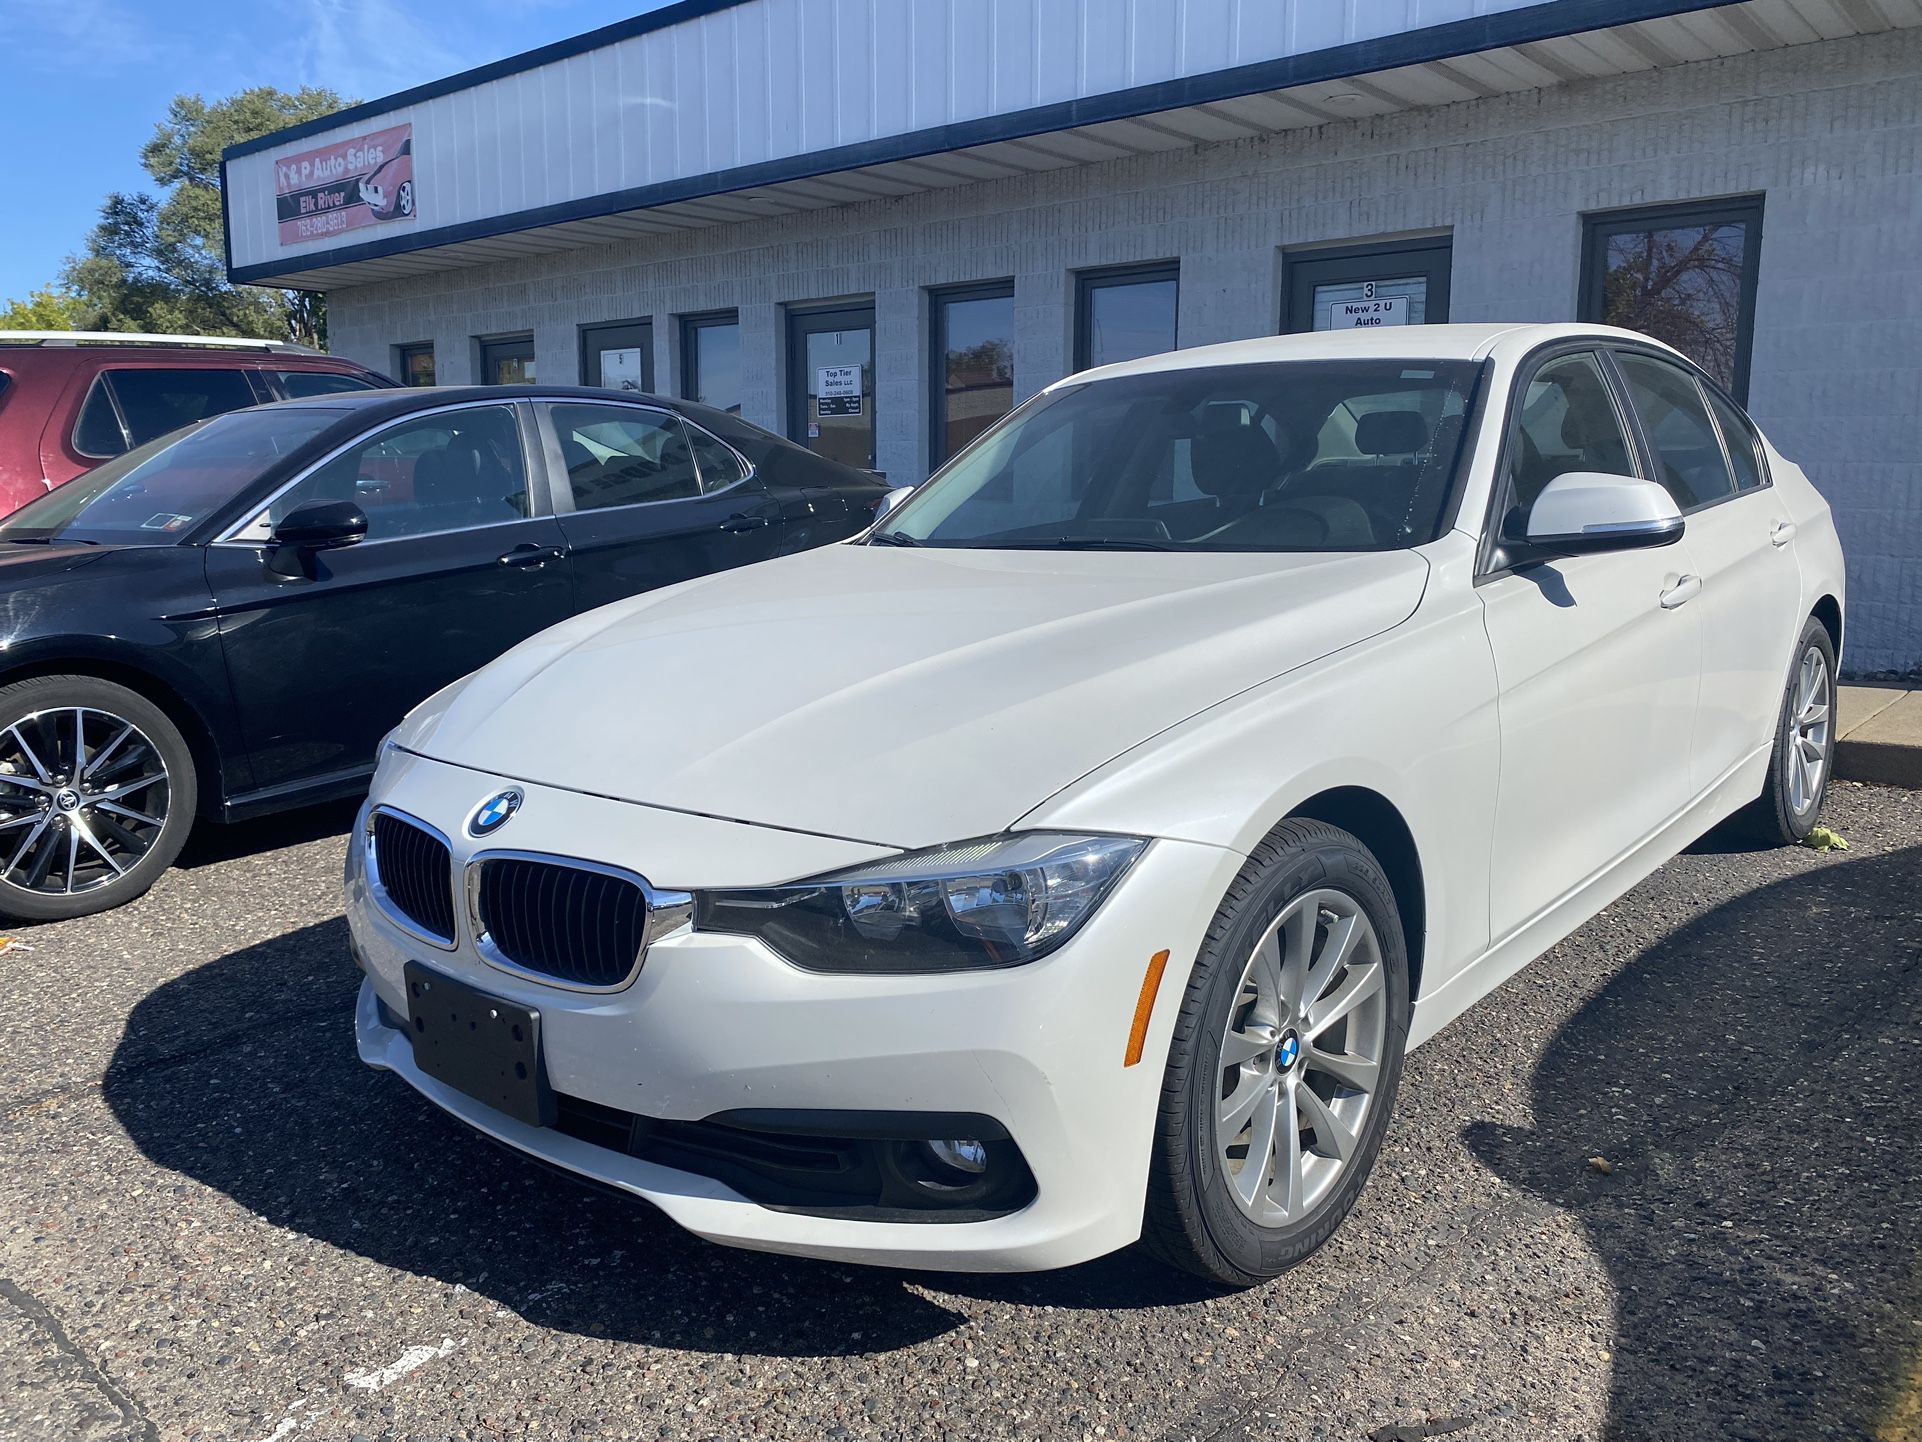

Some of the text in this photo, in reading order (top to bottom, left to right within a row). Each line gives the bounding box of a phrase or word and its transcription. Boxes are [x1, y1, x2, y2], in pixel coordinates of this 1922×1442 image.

[278, 145, 384, 187] K & P Auto Sales
[300, 190, 345, 214] Elk River
[1364, 283, 1374, 298] 3
[1345, 302, 1393, 315] New 2 U
[1355, 317, 1381, 327] Auto
